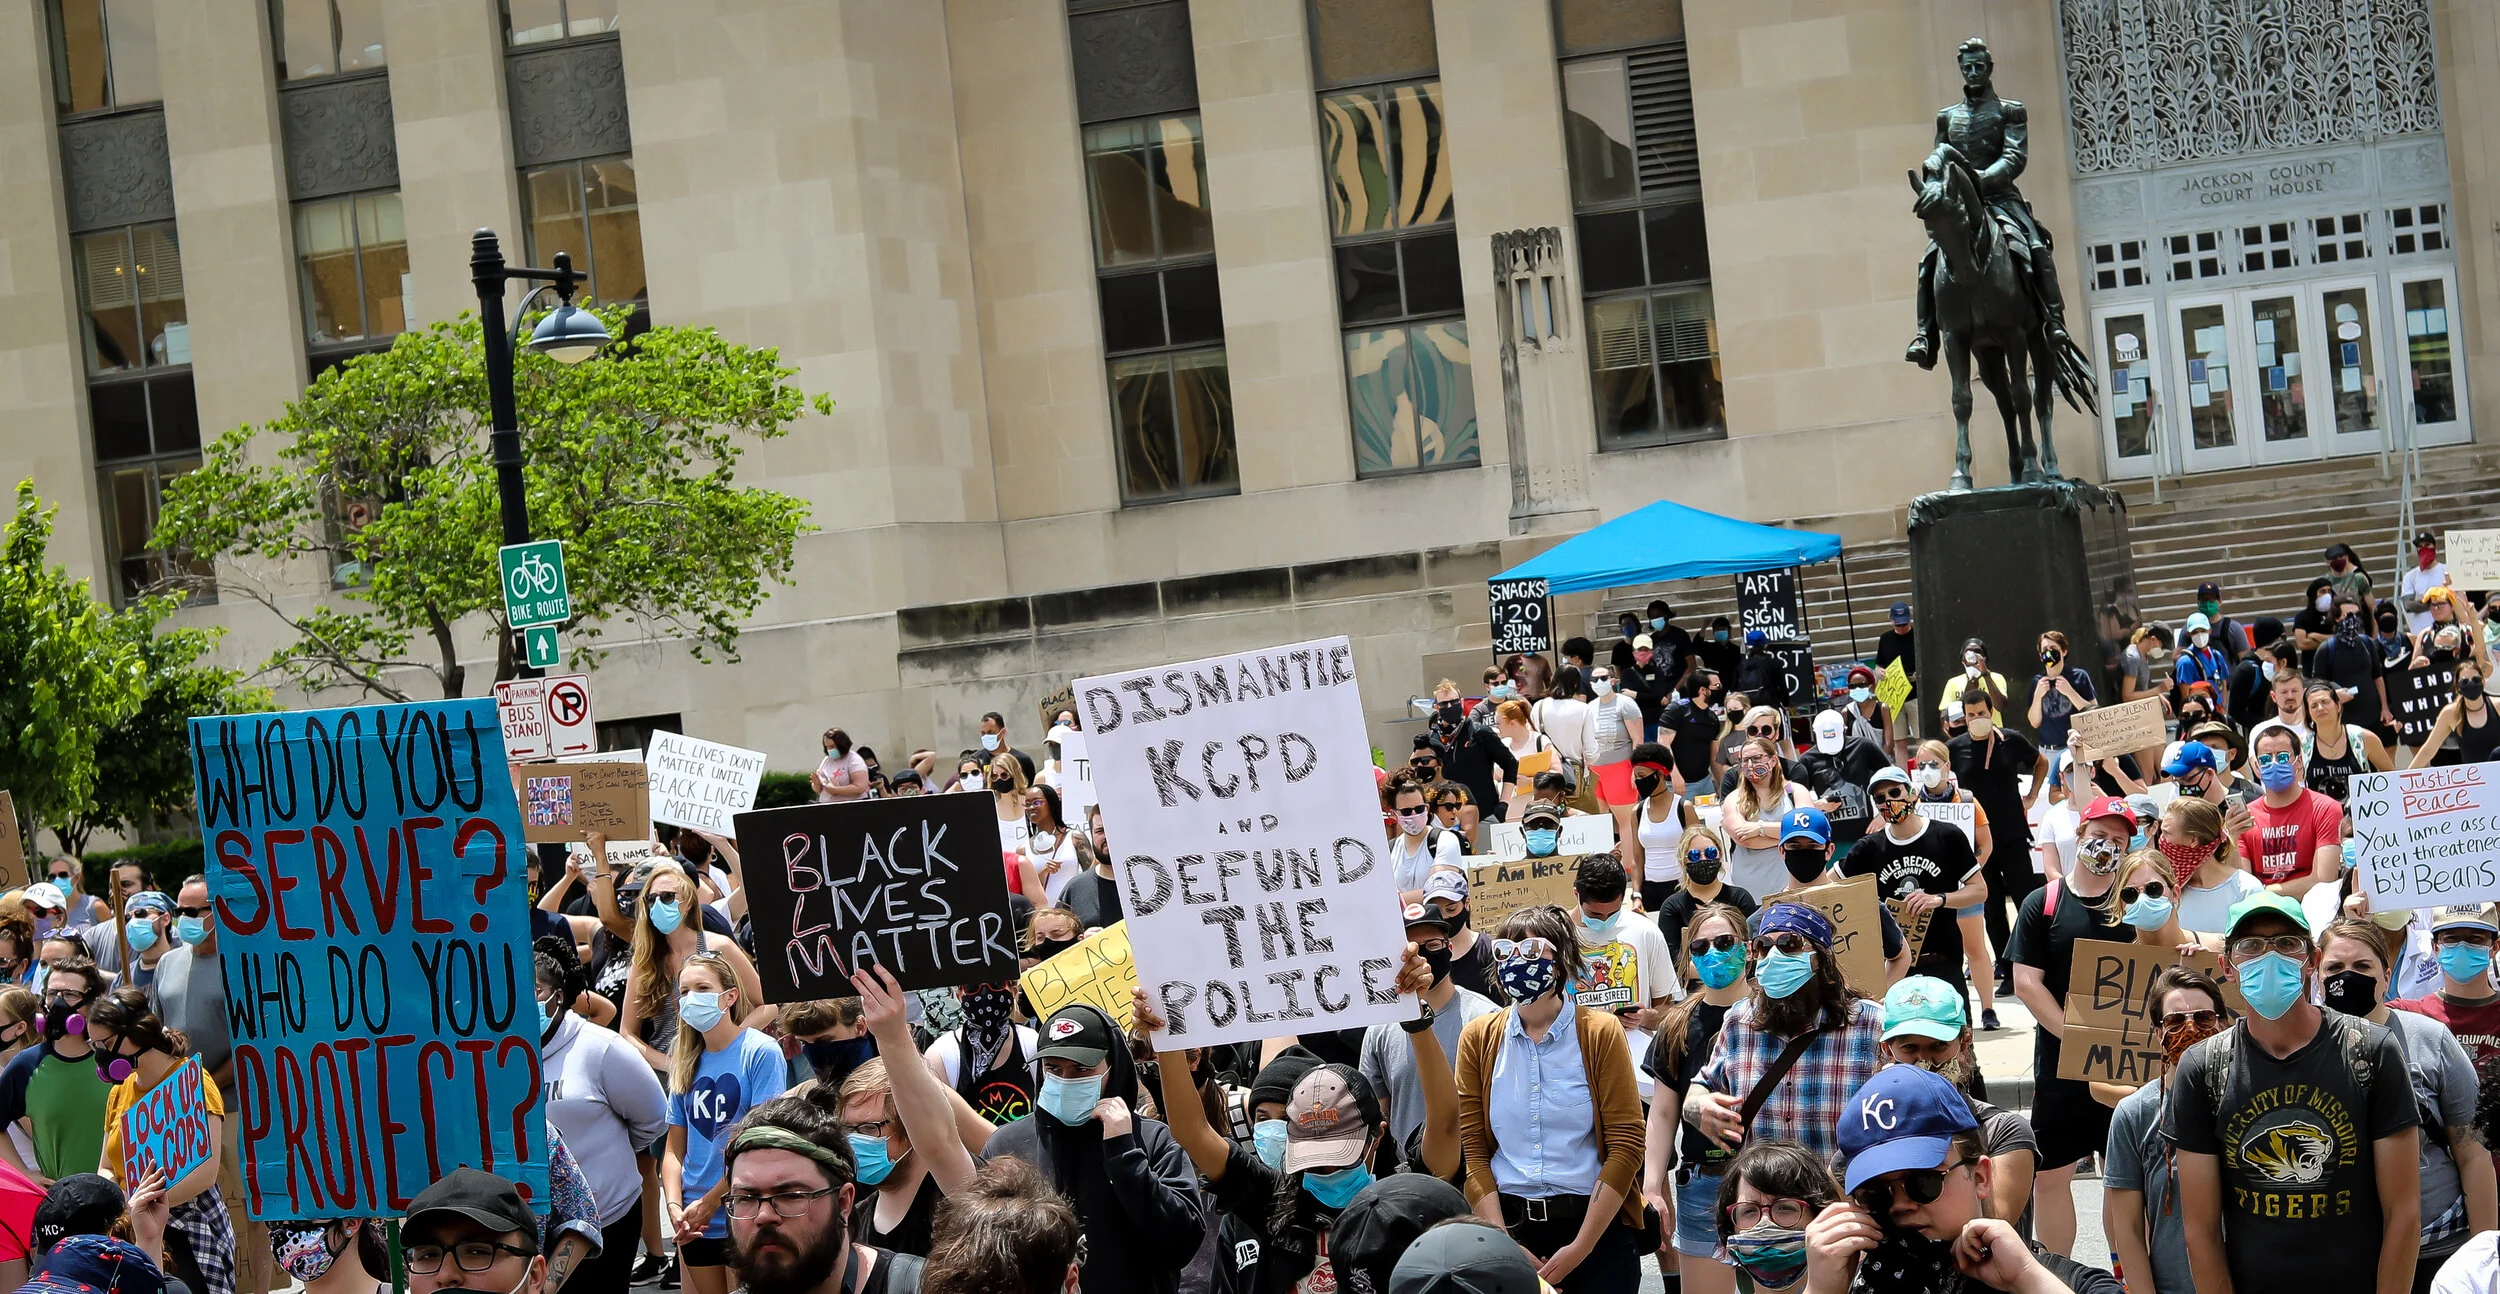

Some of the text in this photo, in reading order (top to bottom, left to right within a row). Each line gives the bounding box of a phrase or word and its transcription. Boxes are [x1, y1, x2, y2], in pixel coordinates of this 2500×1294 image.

[2182, 160, 2336, 192] JACKSON COUNTY
[2200, 179, 2324, 205] COURT HOUSE
[1490, 580, 1545, 602] SNACKS
[1744, 573, 1782, 596] ART
[512, 598, 566, 622] BIKE ROUTE
[1496, 636, 1547, 652] SCREEN
[1503, 624, 1532, 639] SUN
[1083, 645, 1355, 735] DISMANTLE
[2413, 671, 2453, 690] END
[497, 687, 540, 703] NO PARKING
[1041, 687, 1074, 709] BLACK
[2402, 692, 2455, 714] WHIT
[508, 706, 535, 722] BUS
[2080, 701, 2152, 724] TO KEEP SILENT
[504, 722, 543, 739] STAND
[193, 707, 484, 828] WHO DO YOU
[658, 737, 763, 773] ALL LIVES DON'T
[658, 755, 745, 786] MATTER UNTIL
[1145, 731, 1318, 808] KCPD
[2357, 766, 2482, 798] NO Justice
[579, 783, 594, 791] BUT
[648, 772, 750, 809] BLACK LIVES
[579, 801, 610, 811] BLACK
[579, 808, 614, 818] LIVES
[663, 799, 723, 829] MATTER
[1915, 804, 1972, 820] YSTEMIC
[2358, 789, 2471, 820] NO Peace
[579, 817, 626, 828] MATTER
[1218, 813, 1279, 835] AND
[1793, 812, 1810, 828] KC
[2262, 824, 2299, 839] WAKE UP
[2357, 827, 2400, 857] You
[2408, 821, 2451, 843] lame
[2461, 816, 2486, 832] ass
[577, 849, 650, 865] SAY ER NAME
[783, 819, 960, 893] BLACK
[2371, 852, 2408, 871] feel
[214, 817, 508, 941] SERVE?
[1123, 836, 1376, 917] DEFUND
[1472, 869, 1485, 887] I
[1496, 866, 1525, 883] Am
[1532, 861, 1564, 879] Here
[1879, 856, 1942, 885] MILLS RECORD
[1893, 868, 1924, 880] COMPANY
[2374, 860, 2496, 895] by Beans
[1516, 888, 1528, 896] Till
[793, 878, 952, 938] LIVES
[1200, 898, 1335, 970] THE
[786, 912, 1017, 989] MATTER
[1027, 928, 1132, 1010] BLAC
[220, 938, 516, 1040] WHO DO YOU
[1158, 957, 1400, 1036] POLICE
[1578, 989, 1628, 1005] SESAME STREET
[121, 1059, 199, 1161] LOCK UP
[693, 1089, 727, 1123] KC
[1298, 1108, 1340, 1127] GLACIER
[1861, 1093, 1897, 1131] KC
[235, 1034, 544, 1215] PROTECT?
[2225, 1084, 2357, 1169] UNIVERSITY OF MISSOURI
[162, 1101, 208, 1181] COPS
[2234, 1187, 2351, 1219] TIGERS
[44, 1224, 59, 1236] KC
